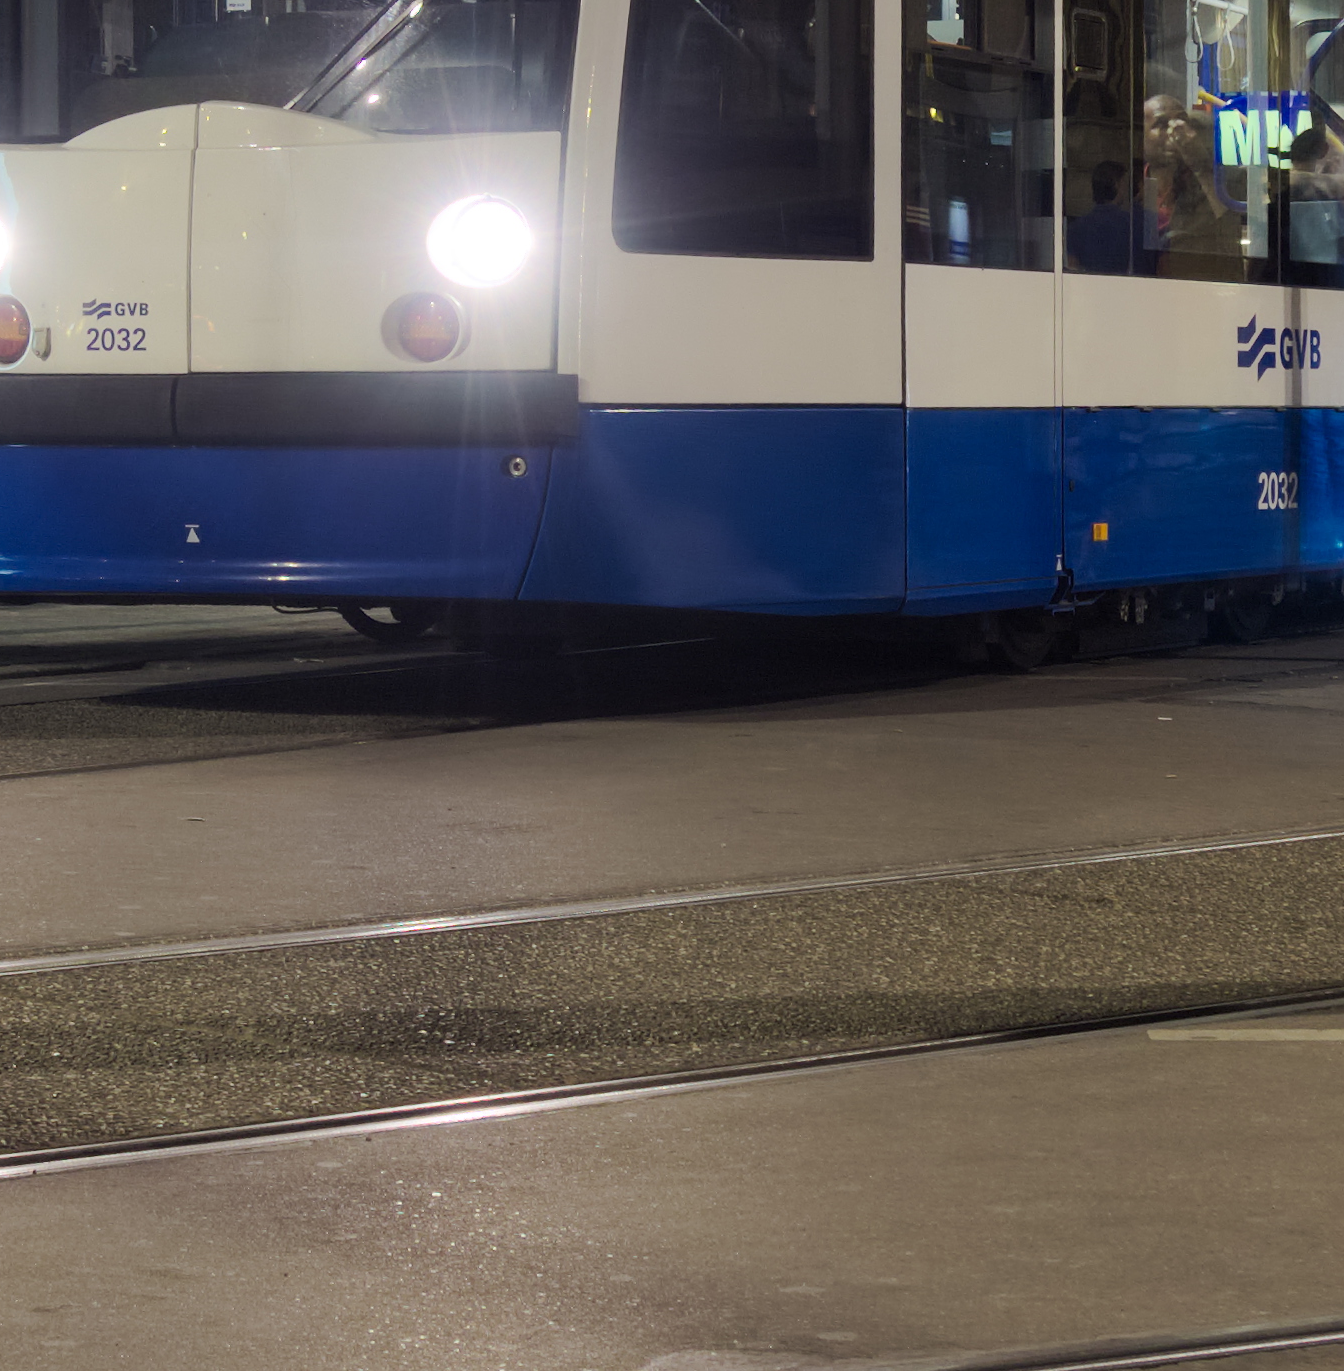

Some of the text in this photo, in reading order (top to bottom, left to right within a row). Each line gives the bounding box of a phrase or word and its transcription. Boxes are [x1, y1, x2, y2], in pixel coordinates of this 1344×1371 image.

[114, 302, 149, 317] GVB
[86, 327, 147, 351] 2032
[1280, 328, 1321, 370] GVB
[1258, 472, 1299, 510] 2032
